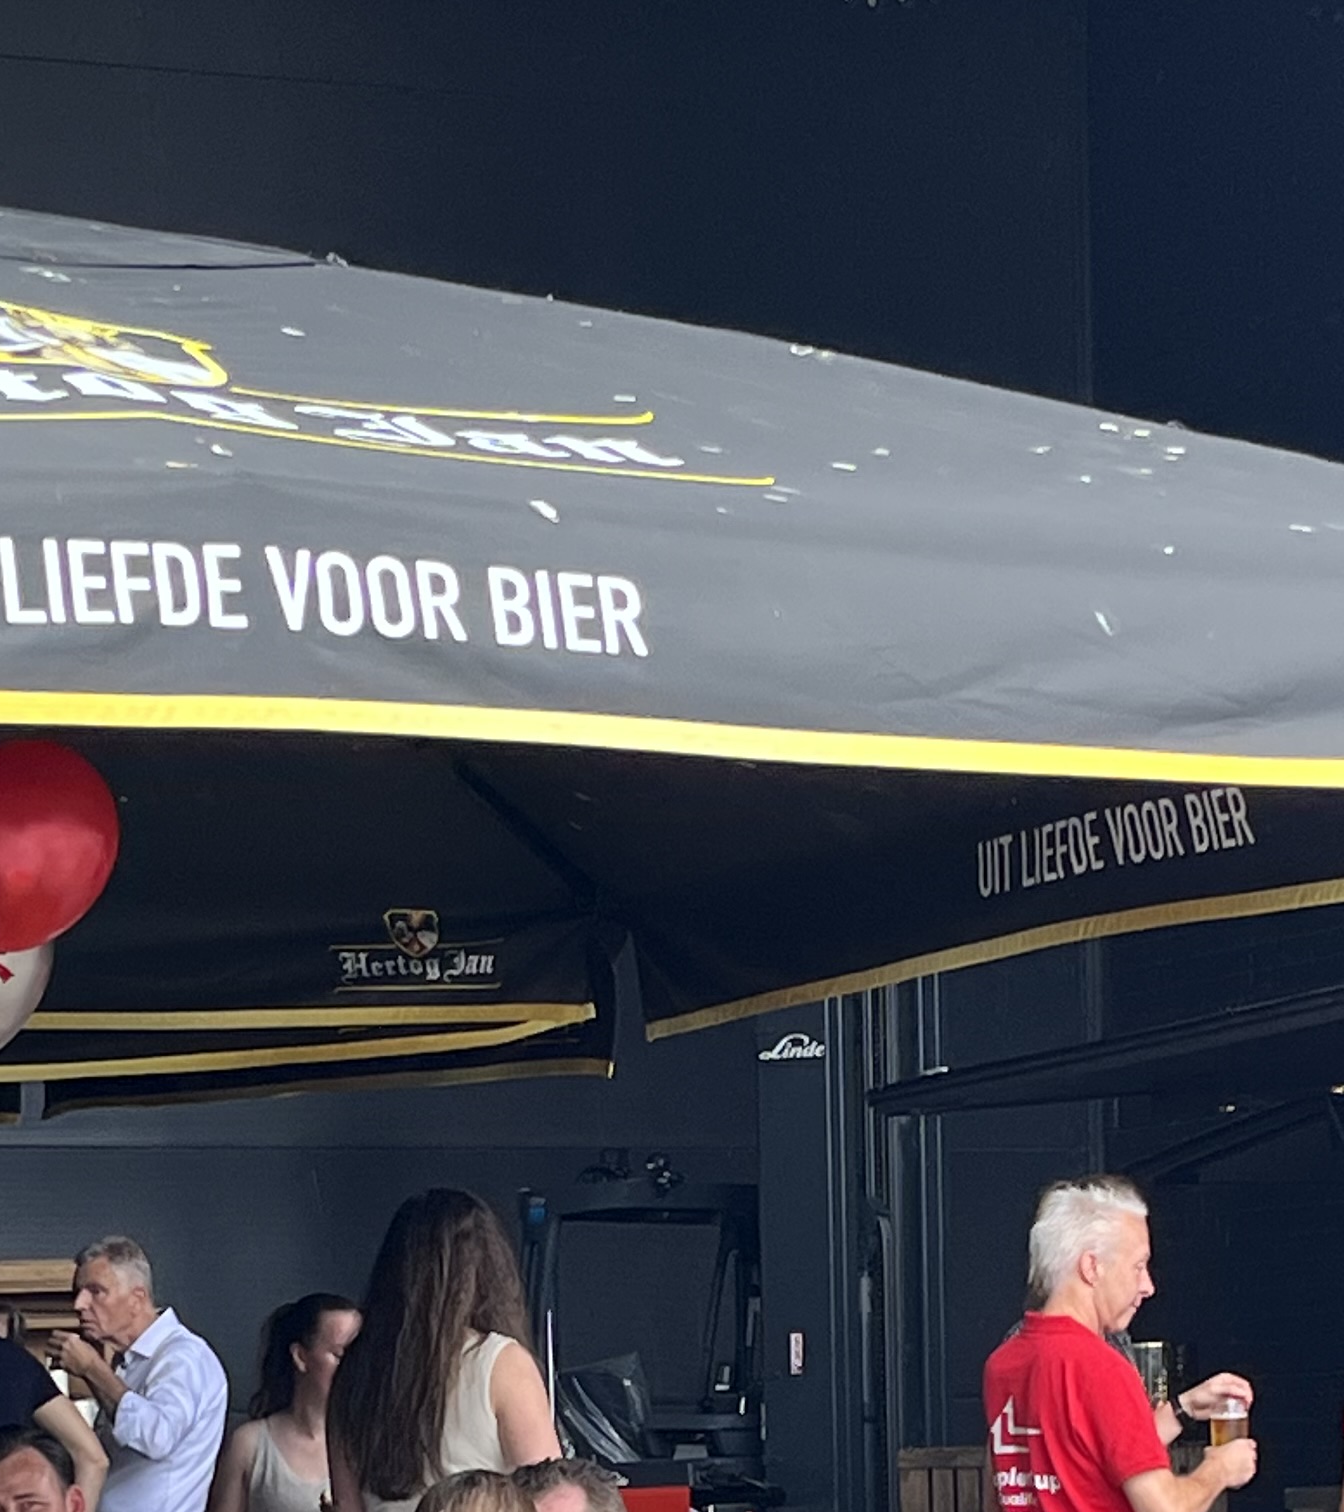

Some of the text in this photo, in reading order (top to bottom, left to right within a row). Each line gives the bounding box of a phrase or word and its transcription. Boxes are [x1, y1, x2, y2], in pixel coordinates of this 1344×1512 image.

[294, 403, 686, 467] Jan
[264, 545, 468, 642] VOOR
[488, 565, 649, 657] BIER
[977, 786, 1256, 898] UIT LIEFDE VOOR BIER
[338, 948, 495, 984] Hertog Jan
[758, 1032, 825, 1061] Linde
